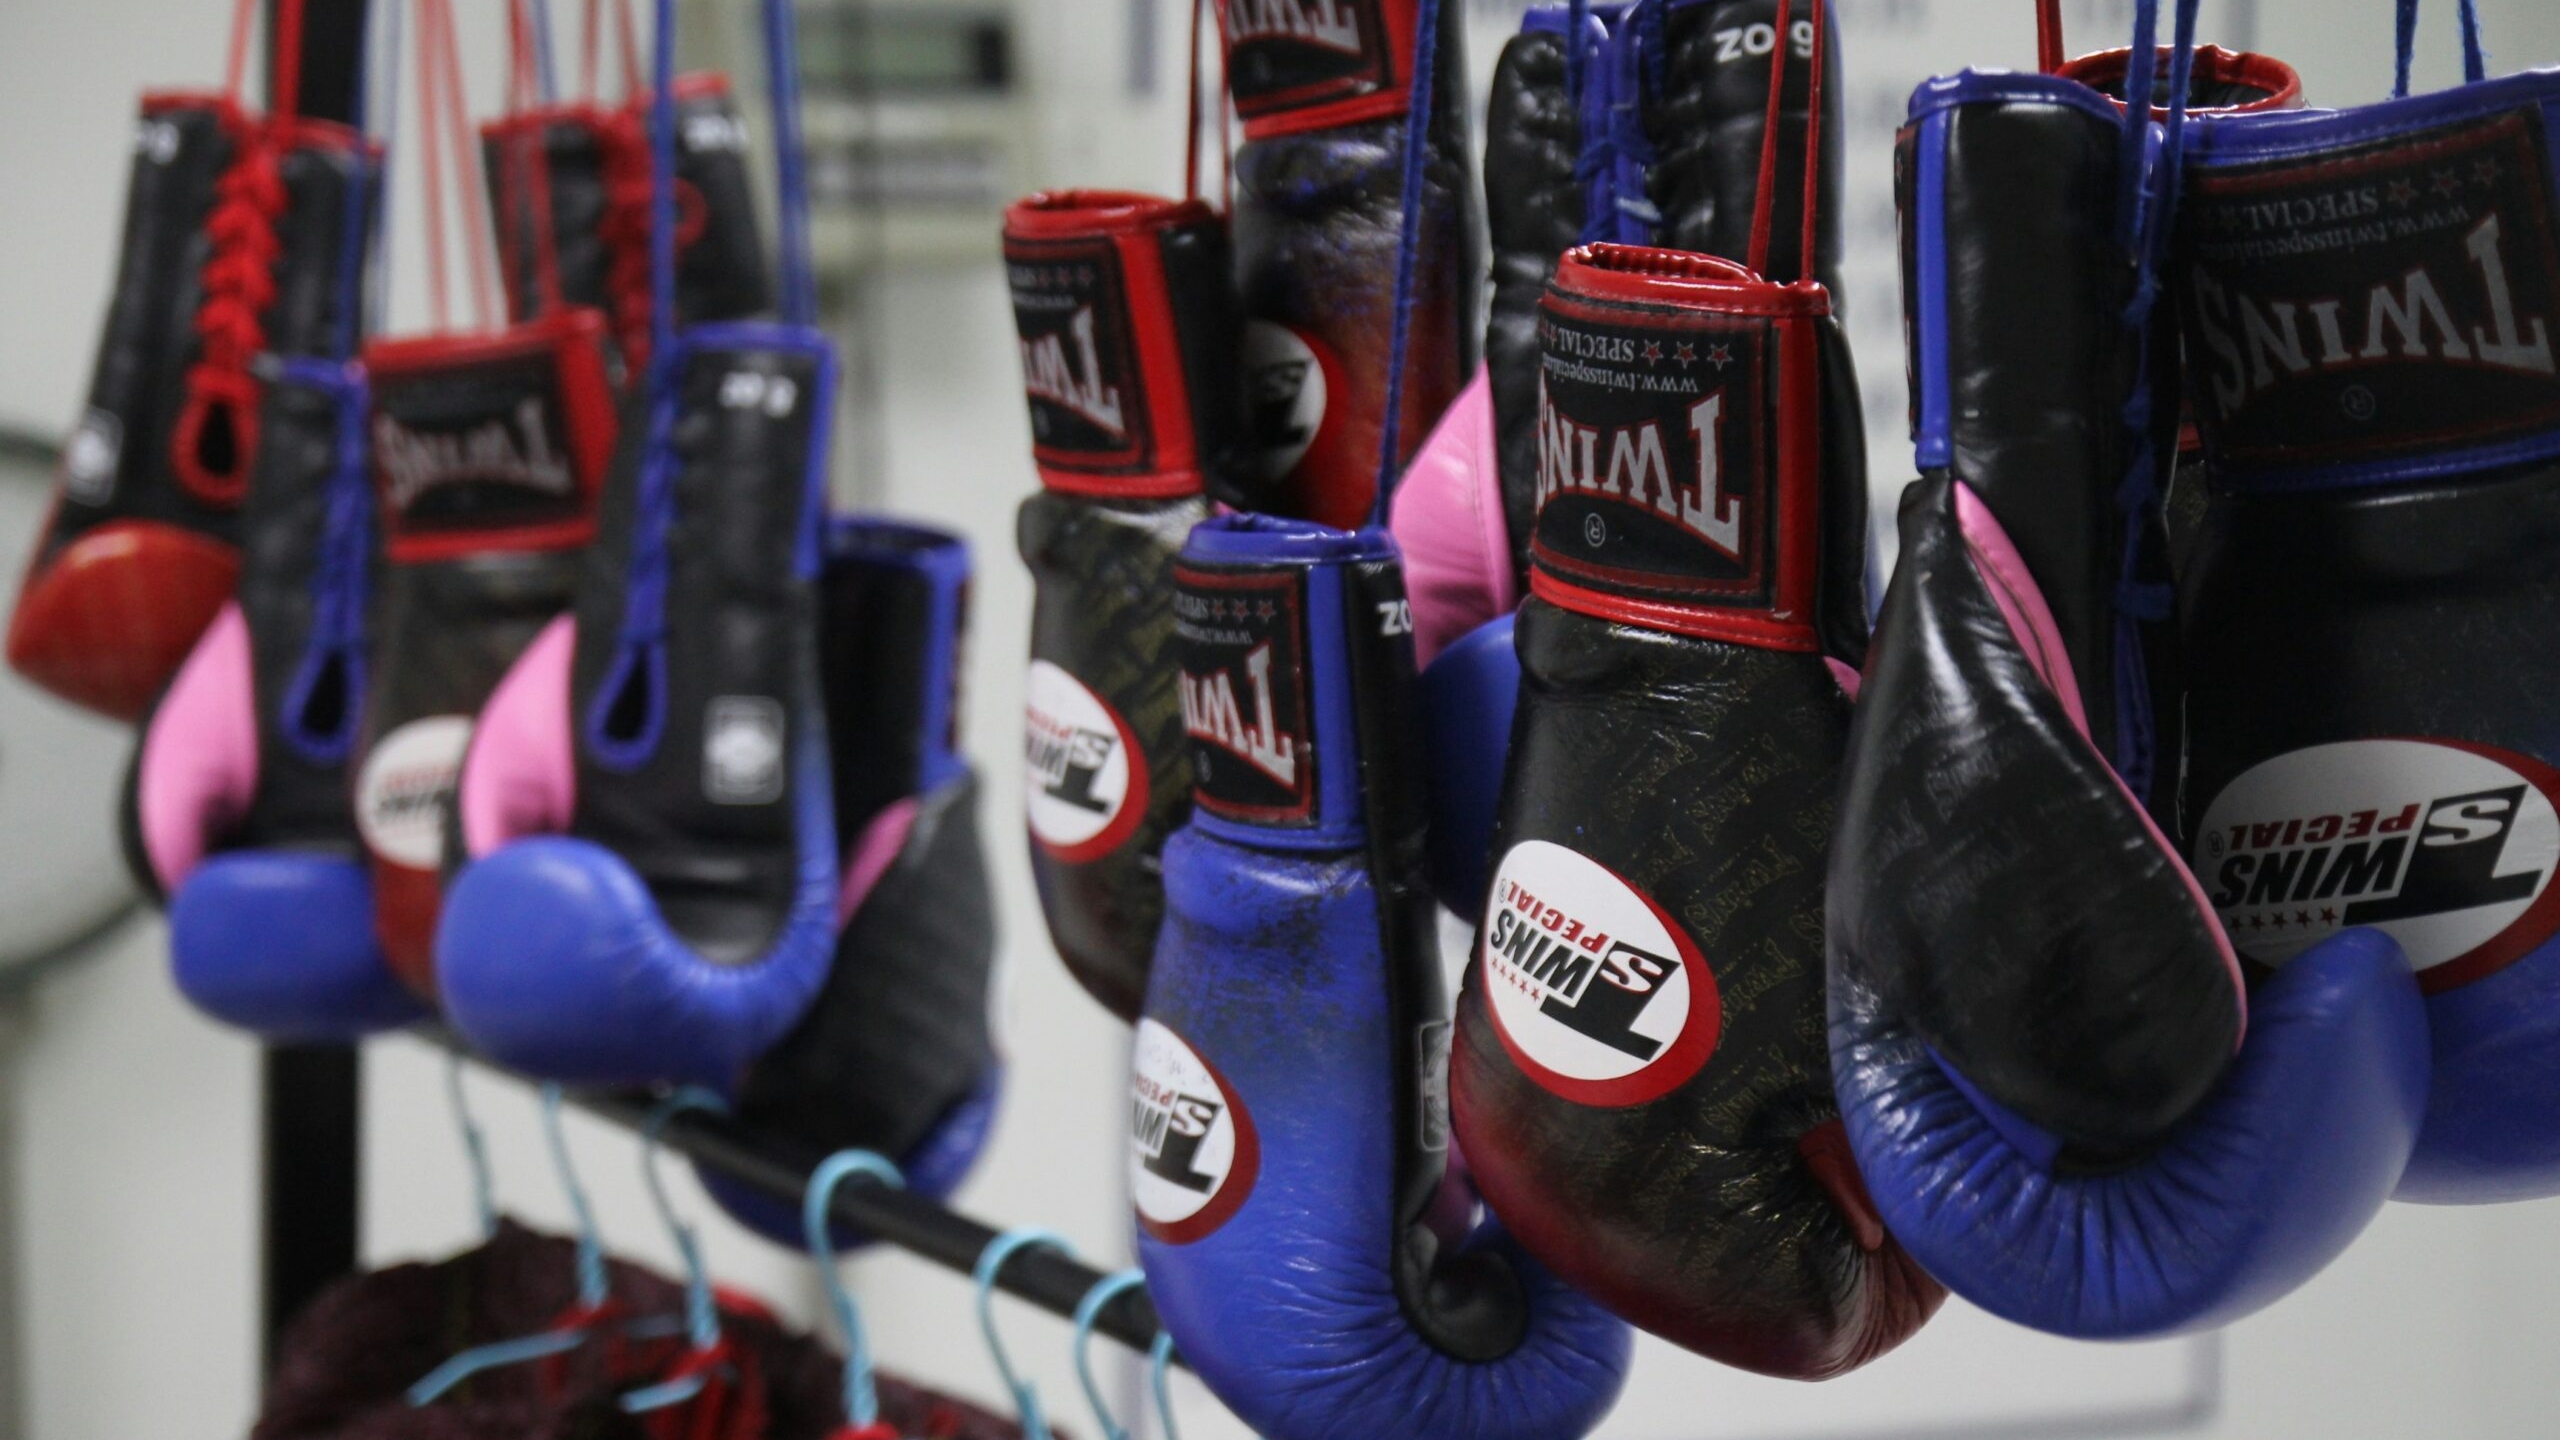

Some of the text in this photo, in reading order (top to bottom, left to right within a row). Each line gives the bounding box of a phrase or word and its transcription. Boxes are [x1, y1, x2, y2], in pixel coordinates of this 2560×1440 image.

[1714, 23, 1777, 62] OZ
[2244, 187, 2380, 231] SPECIAL
[2193, 212, 2556, 421] TWINS
[1558, 328, 1635, 362] SPECIAL
[1020, 307, 1126, 429] TWI
